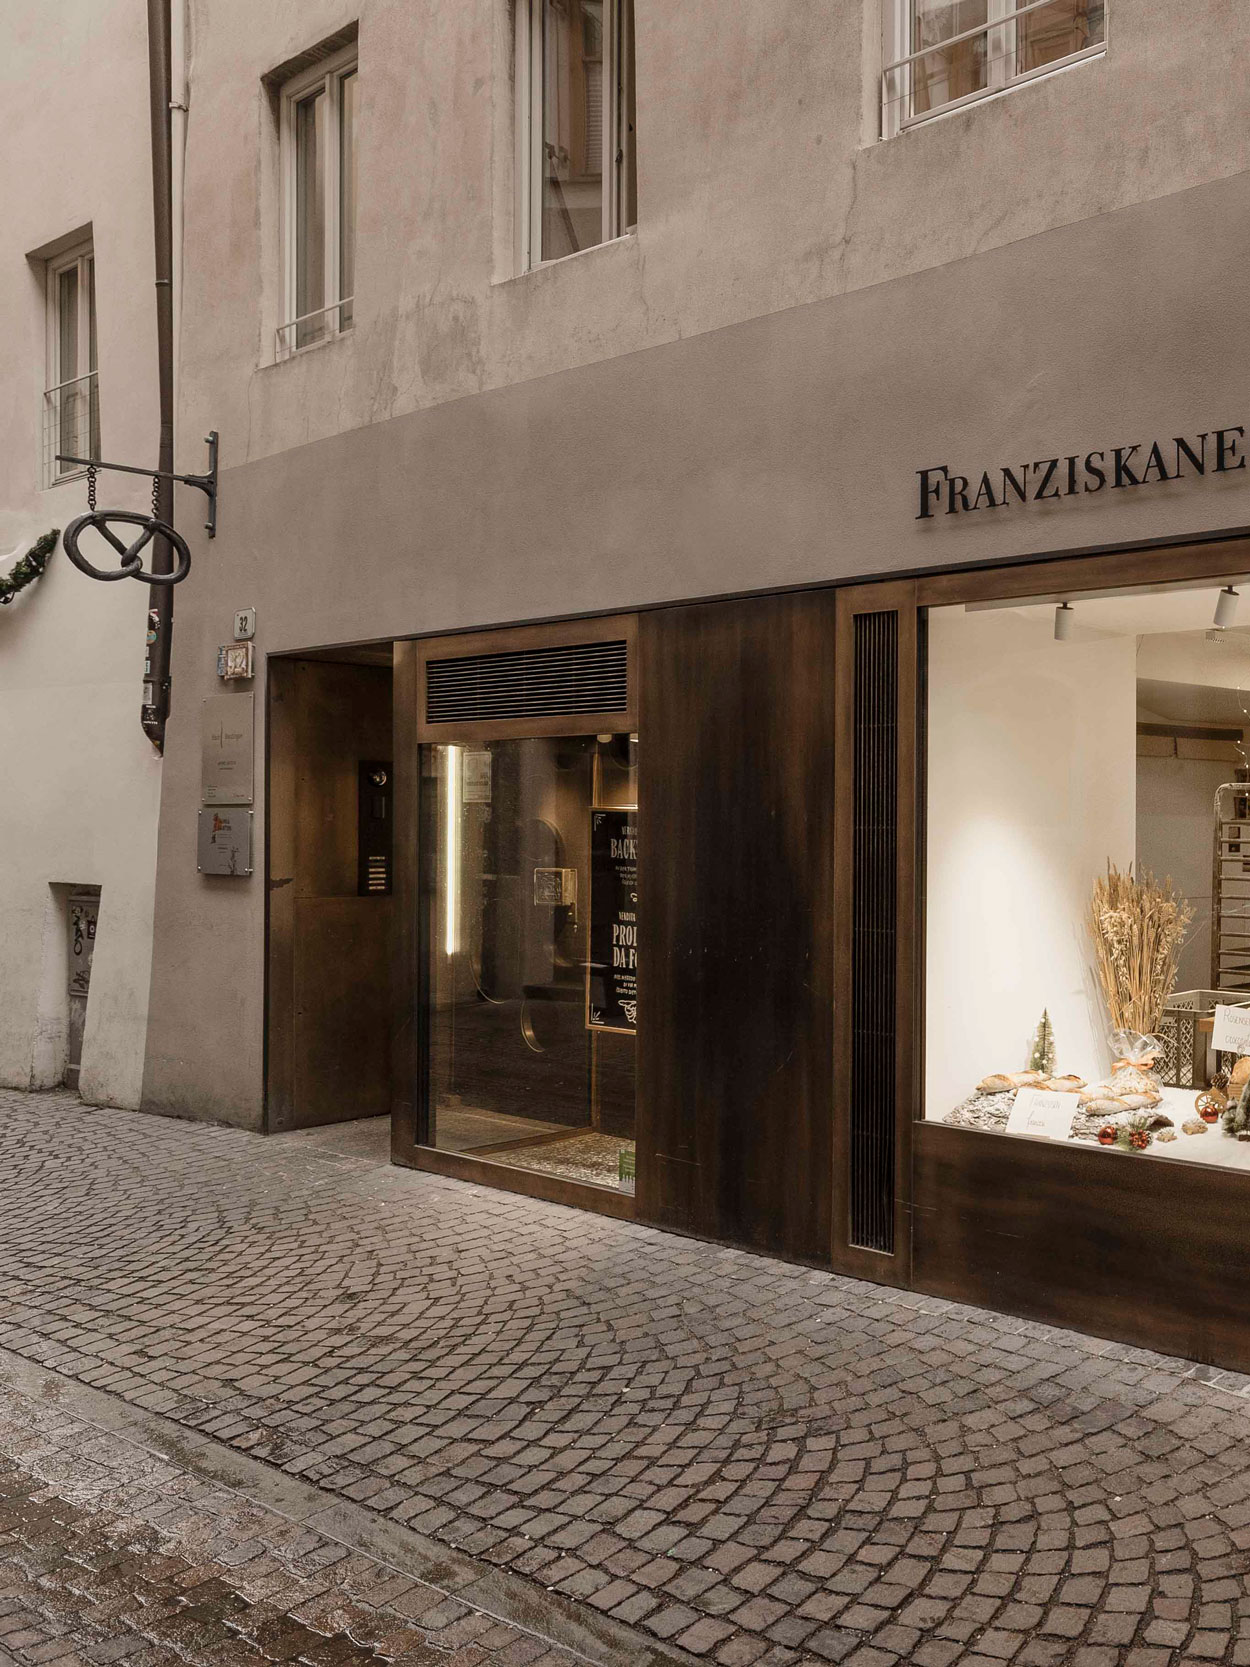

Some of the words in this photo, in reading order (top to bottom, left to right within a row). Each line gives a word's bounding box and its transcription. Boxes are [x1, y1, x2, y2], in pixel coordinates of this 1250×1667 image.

[238, 615, 249, 633] 32
[610, 838, 638, 860] BACK
[613, 946, 626, 968] DA
